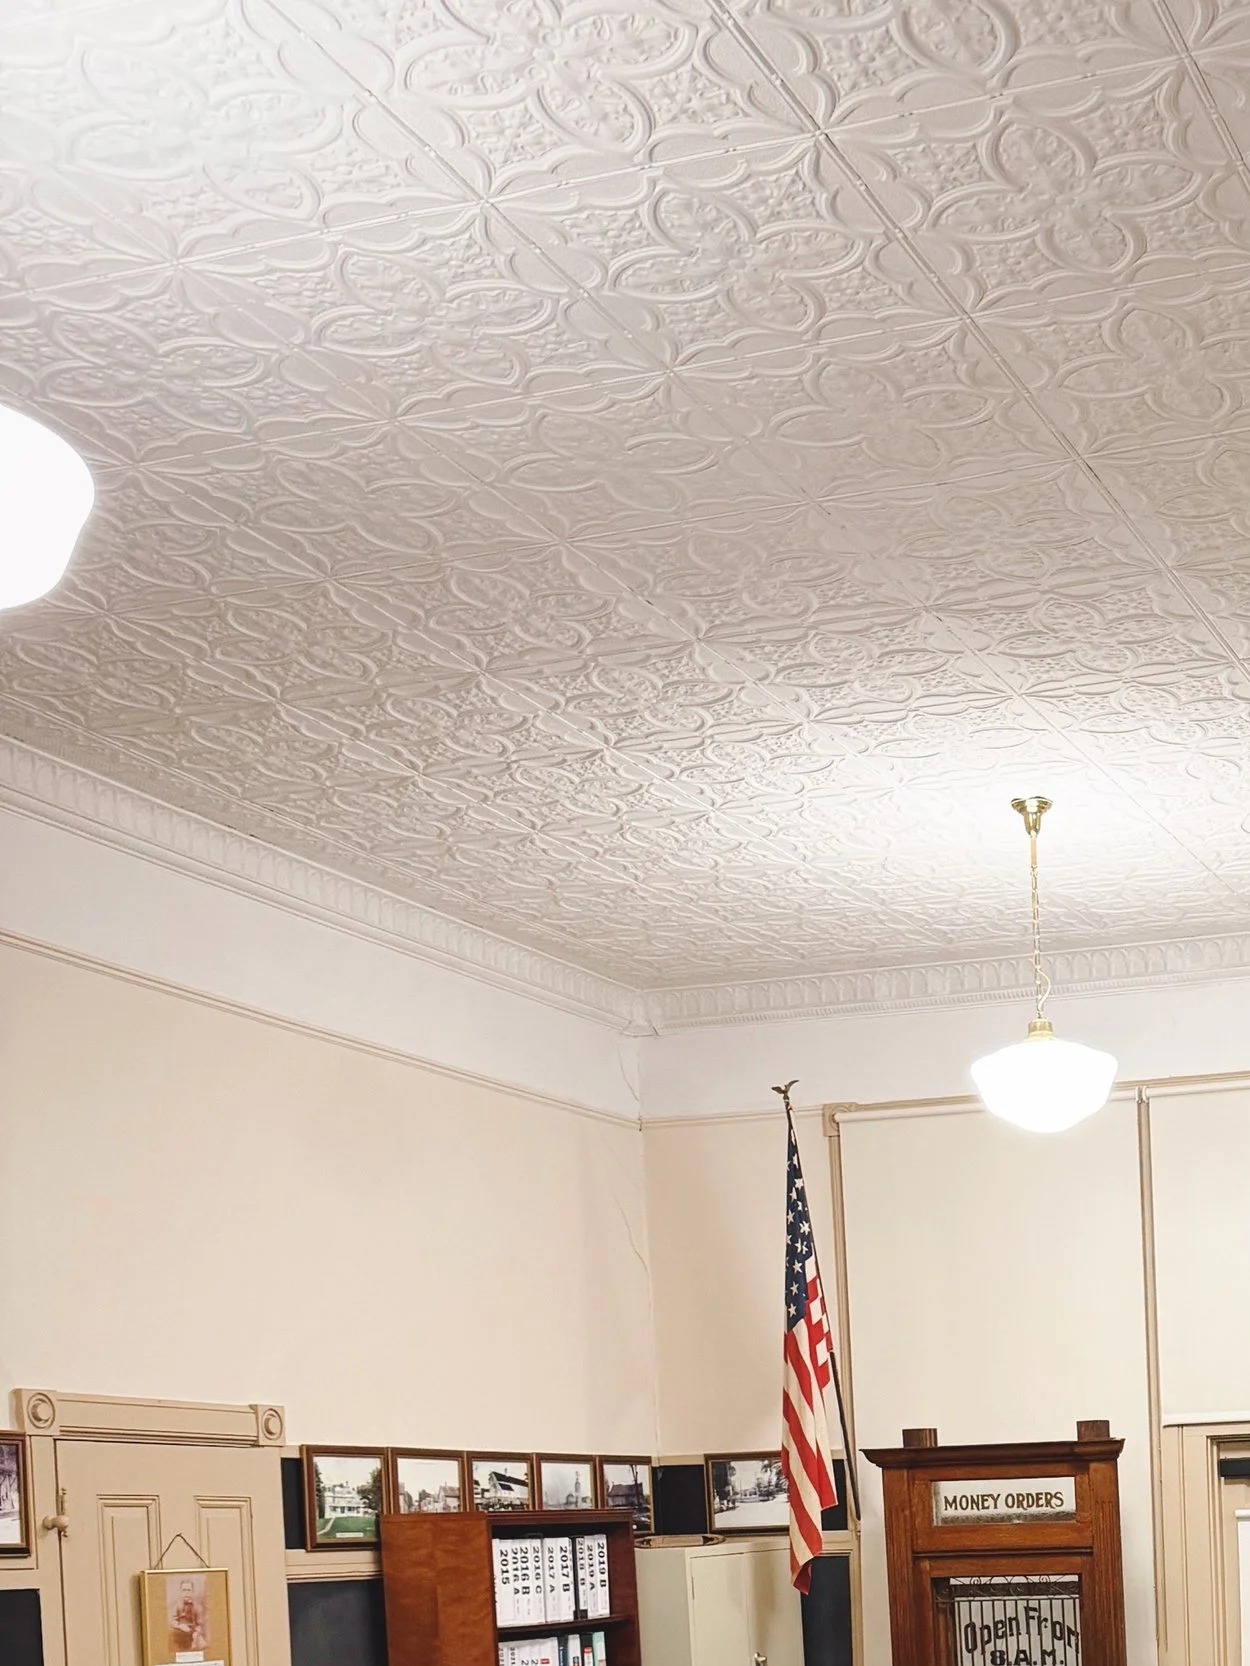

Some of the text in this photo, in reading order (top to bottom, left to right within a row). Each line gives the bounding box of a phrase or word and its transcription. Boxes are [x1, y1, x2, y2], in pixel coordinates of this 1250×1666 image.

[944, 1491, 1065, 1511] MONEY ORDERS
[500, 1549, 510, 1585] 2015
[520, 1547, 531, 1595] 2016 B
[547, 1546, 556, 1593] 2017 A
[559, 1546, 570, 1578] 2017
[586, 1544, 596, 1590] 2019 A
[597, 1542, 607, 1575] 2019
[562, 1583, 571, 1592] B
[964, 1616, 1021, 1655] Open
